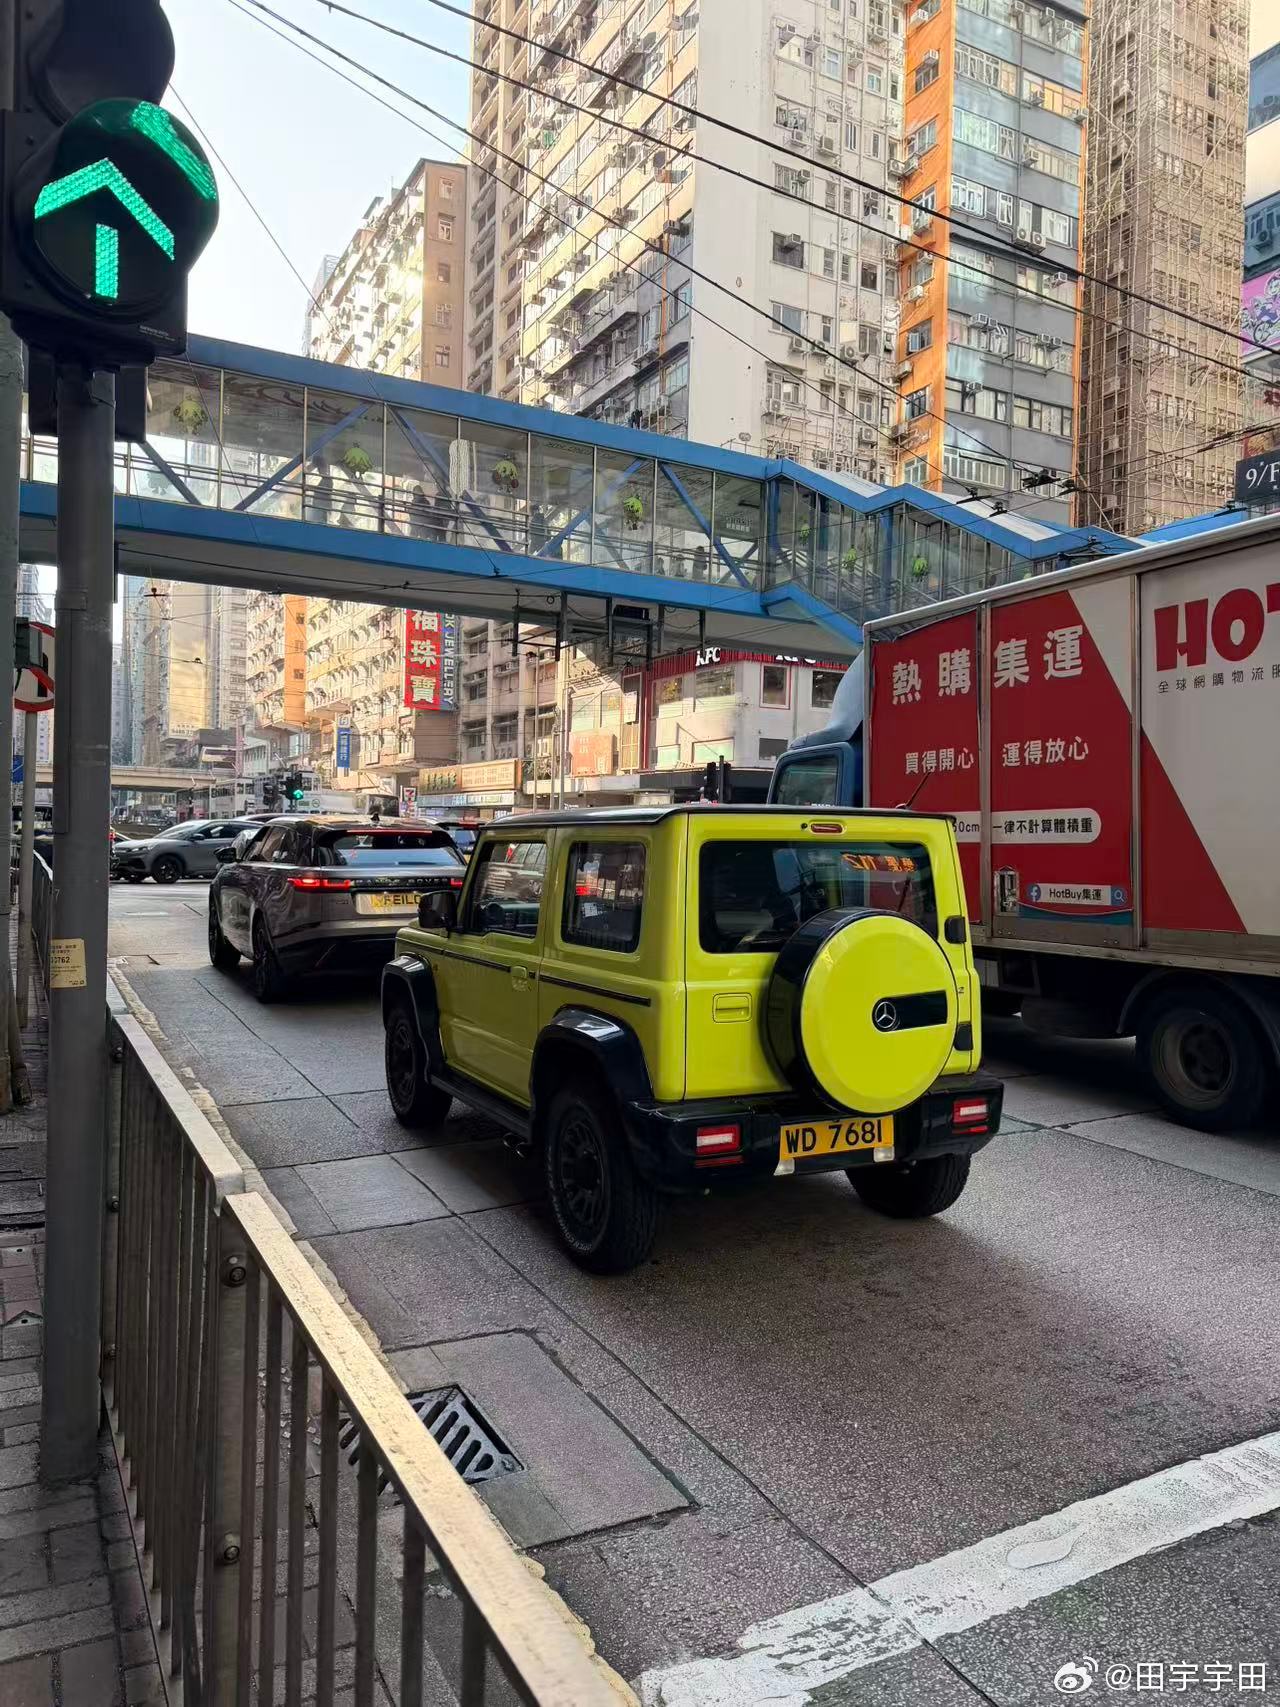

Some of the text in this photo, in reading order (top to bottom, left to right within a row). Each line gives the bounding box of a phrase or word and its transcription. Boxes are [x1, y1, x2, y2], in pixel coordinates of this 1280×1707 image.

[443, 631, 454, 704] JEWELLERY
[905, 736, 1089, 775] 買得開心 運得放心
[992, 817, 1093, 834] 一律不計算體積重
[785, 1119, 882, 1154] WD 7681
